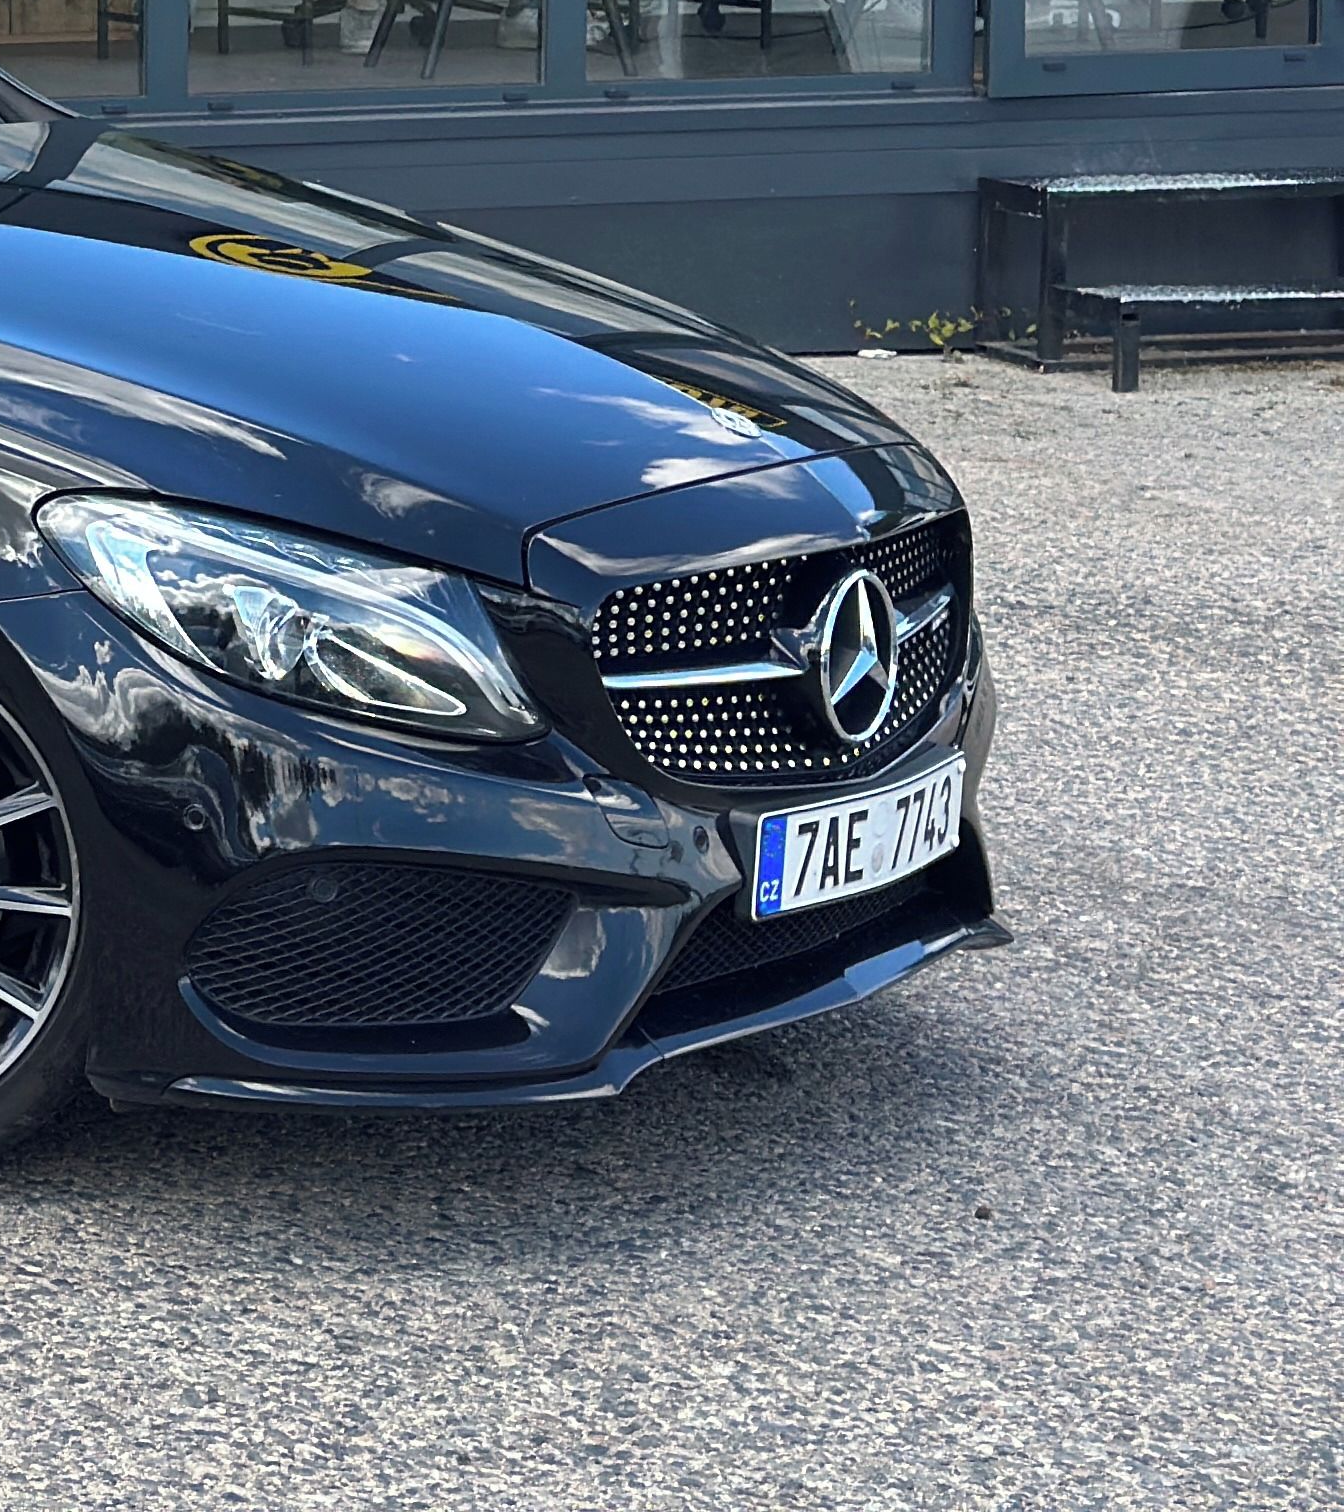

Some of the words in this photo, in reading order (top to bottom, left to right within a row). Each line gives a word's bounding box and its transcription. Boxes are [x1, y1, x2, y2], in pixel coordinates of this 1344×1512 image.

[794, 809, 868, 896] 7AE
[891, 775, 951, 870] 7743
[759, 879, 780, 903] CZ
